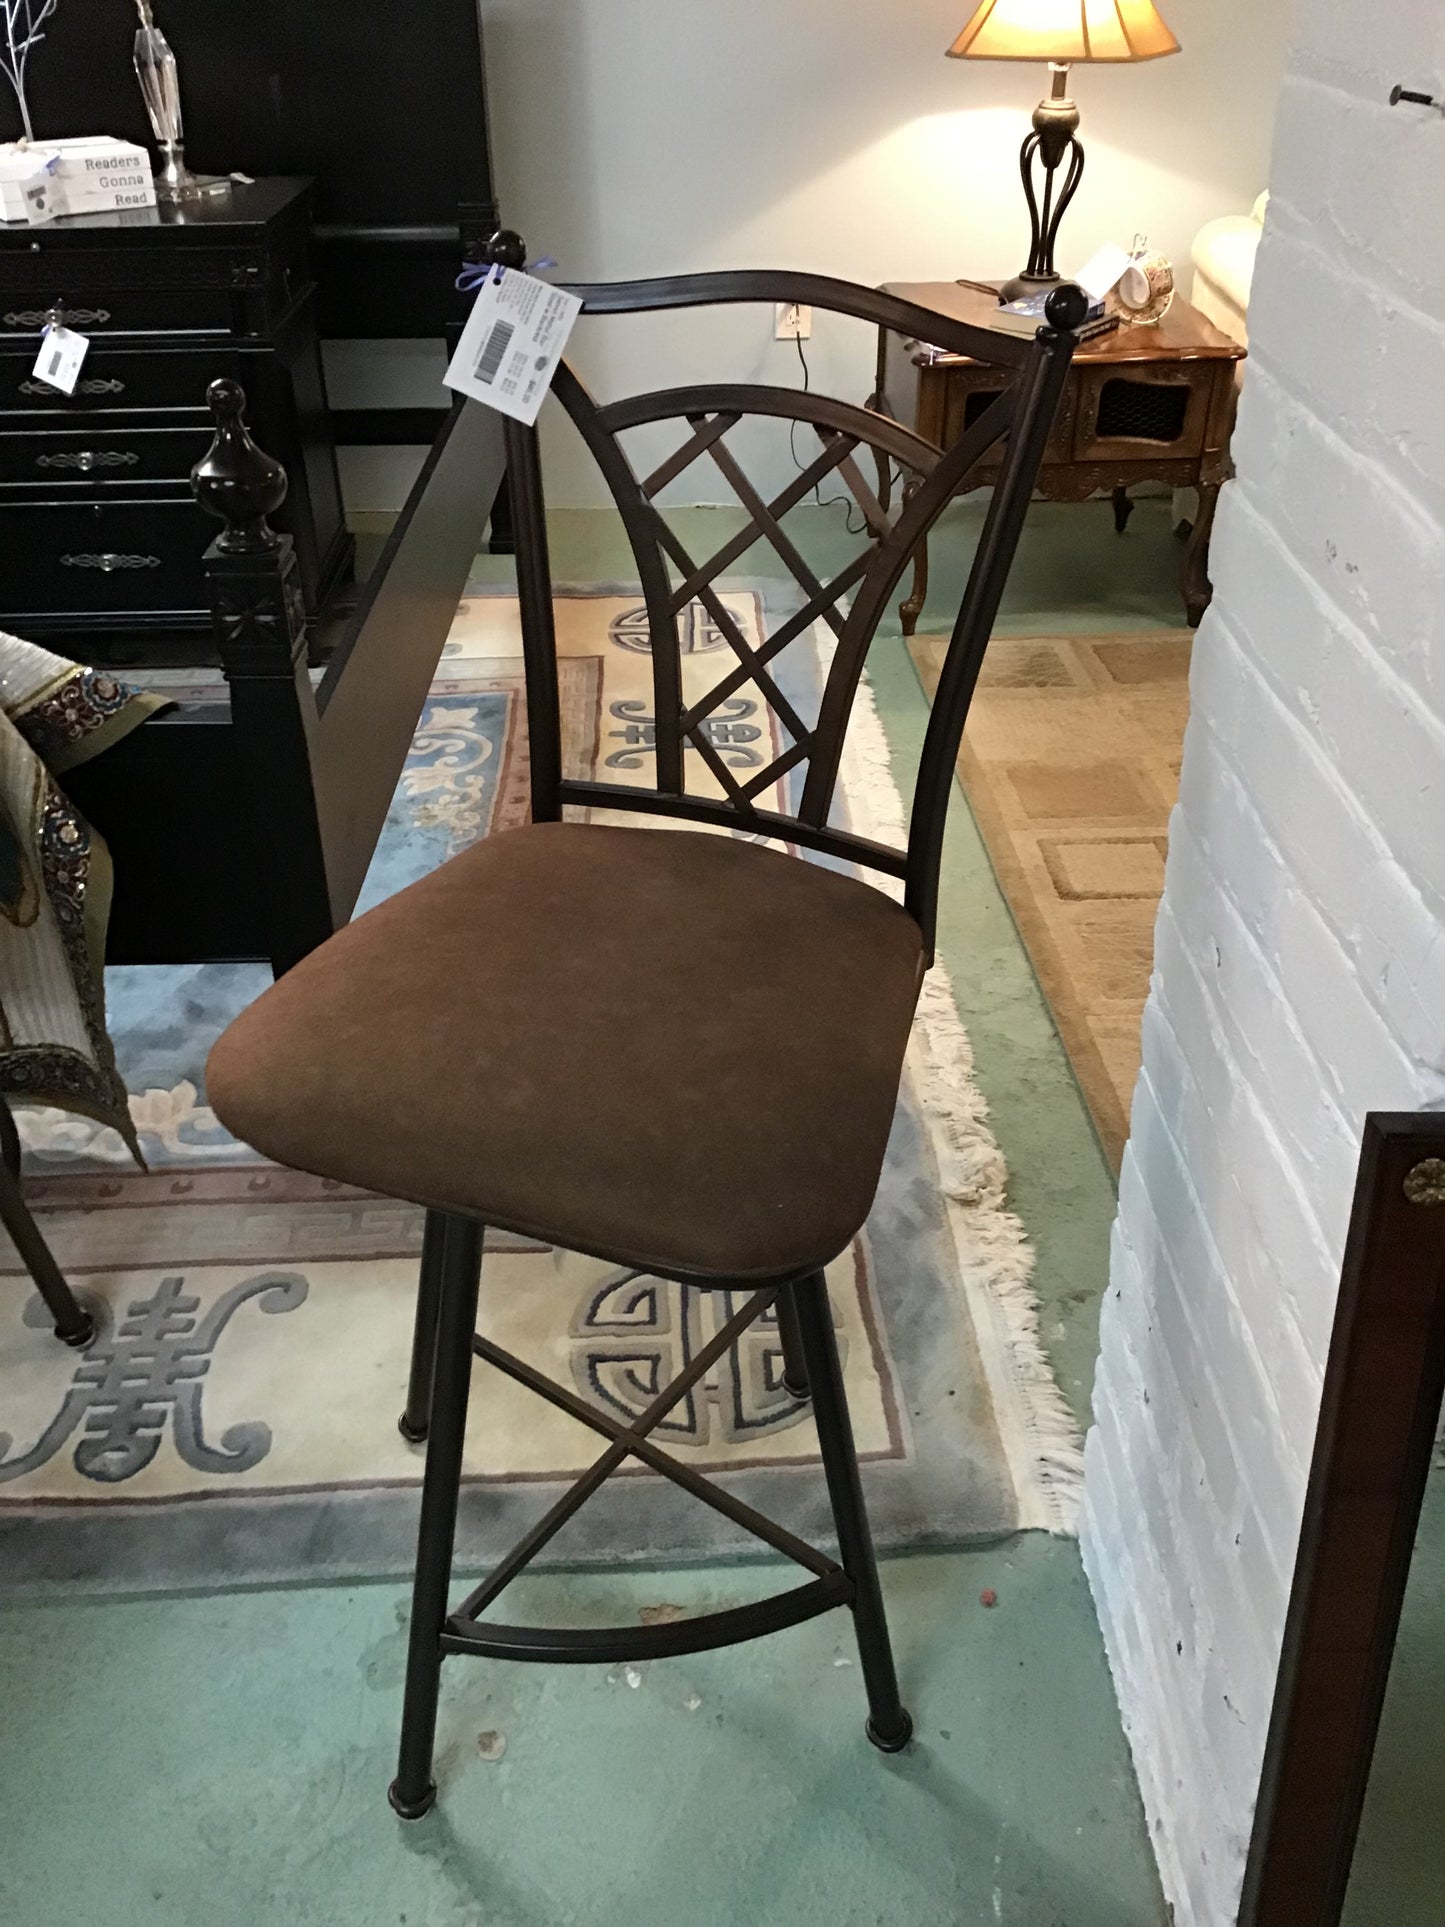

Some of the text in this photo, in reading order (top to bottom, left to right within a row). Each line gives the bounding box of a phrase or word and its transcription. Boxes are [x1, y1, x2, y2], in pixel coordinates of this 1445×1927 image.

[84, 157, 140, 171] Readers
[99, 175, 143, 187] Gonna
[114, 192, 146, 206] Read
